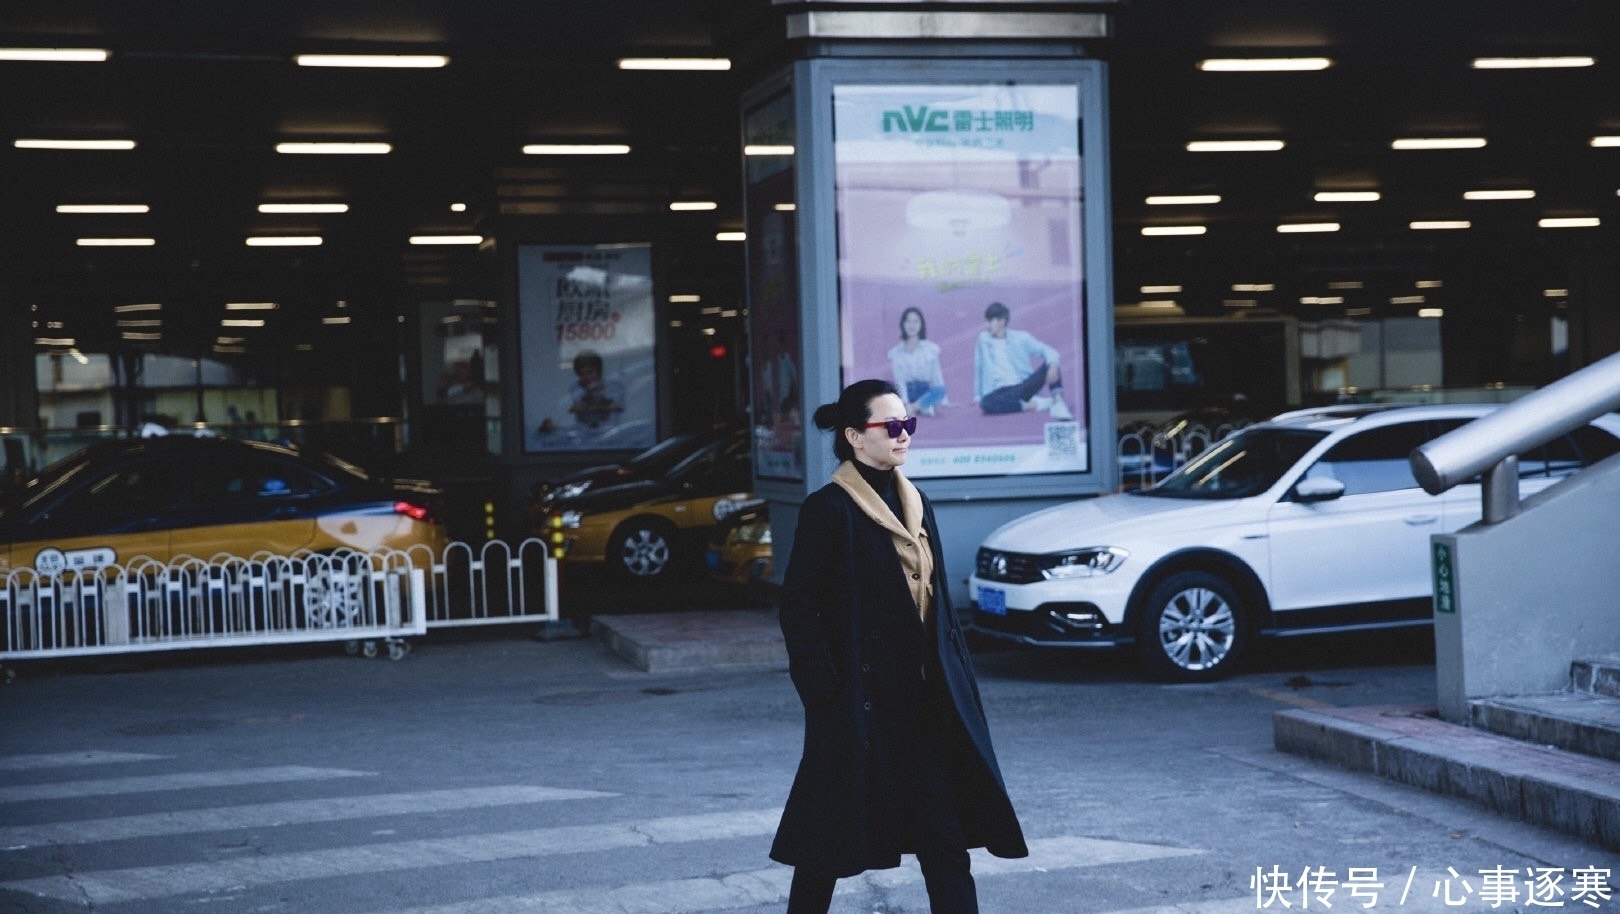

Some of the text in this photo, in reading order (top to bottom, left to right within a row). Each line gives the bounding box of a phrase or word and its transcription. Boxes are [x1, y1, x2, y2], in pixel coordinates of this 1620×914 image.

[954, 110, 1034, 131] 雷士照明
[555, 321, 616, 341] 15800
